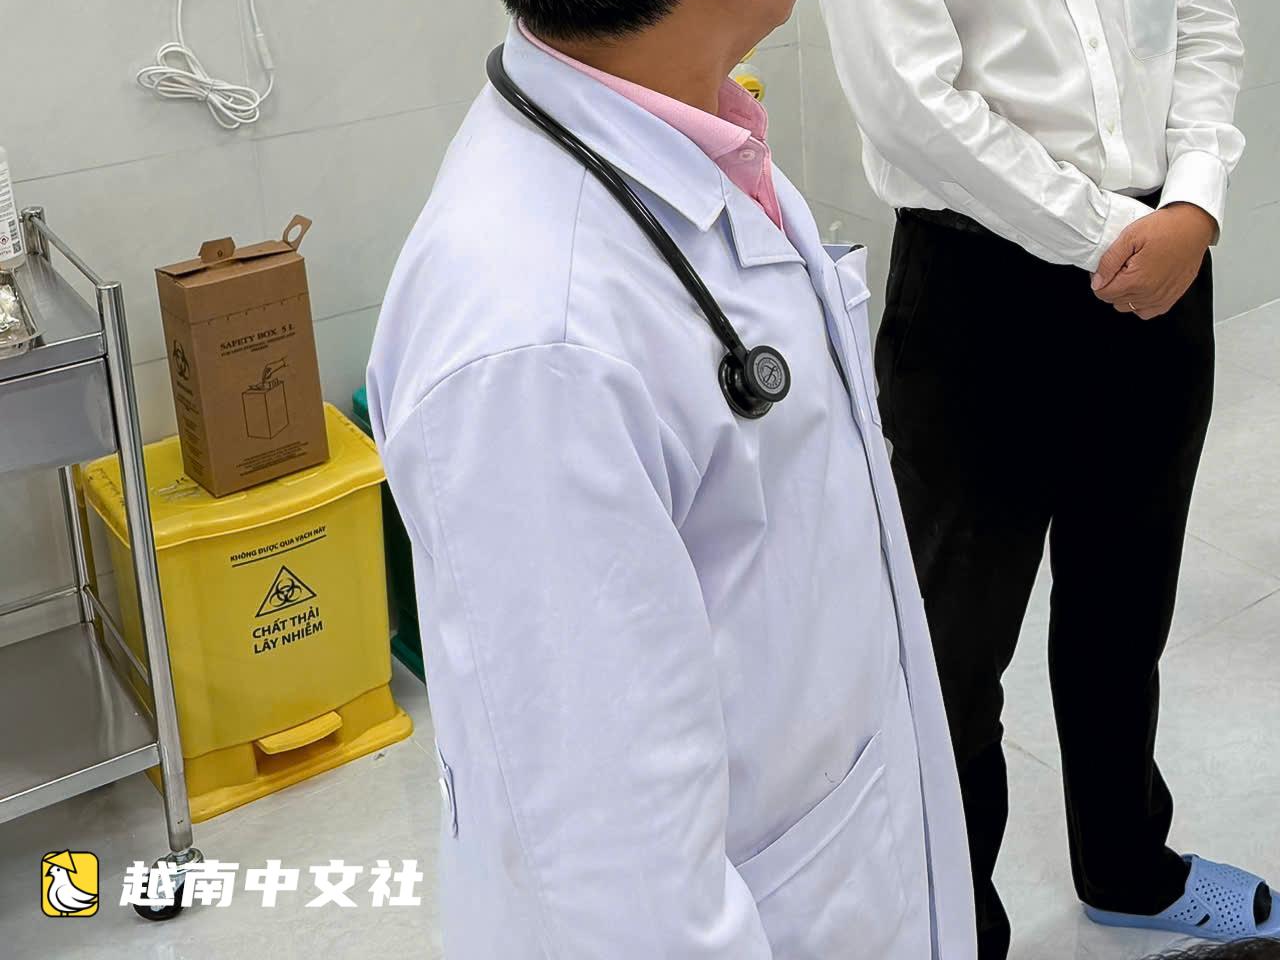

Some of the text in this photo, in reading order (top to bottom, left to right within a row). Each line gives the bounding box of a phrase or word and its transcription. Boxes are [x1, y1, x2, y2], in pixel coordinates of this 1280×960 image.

[220, 335, 255, 349] SAFETY
[257, 328, 277, 339] BOX
[281, 325, 287, 333] 5
[280, 538, 295, 548] QUA
[252, 606, 320, 639] CHẤT THẢI
